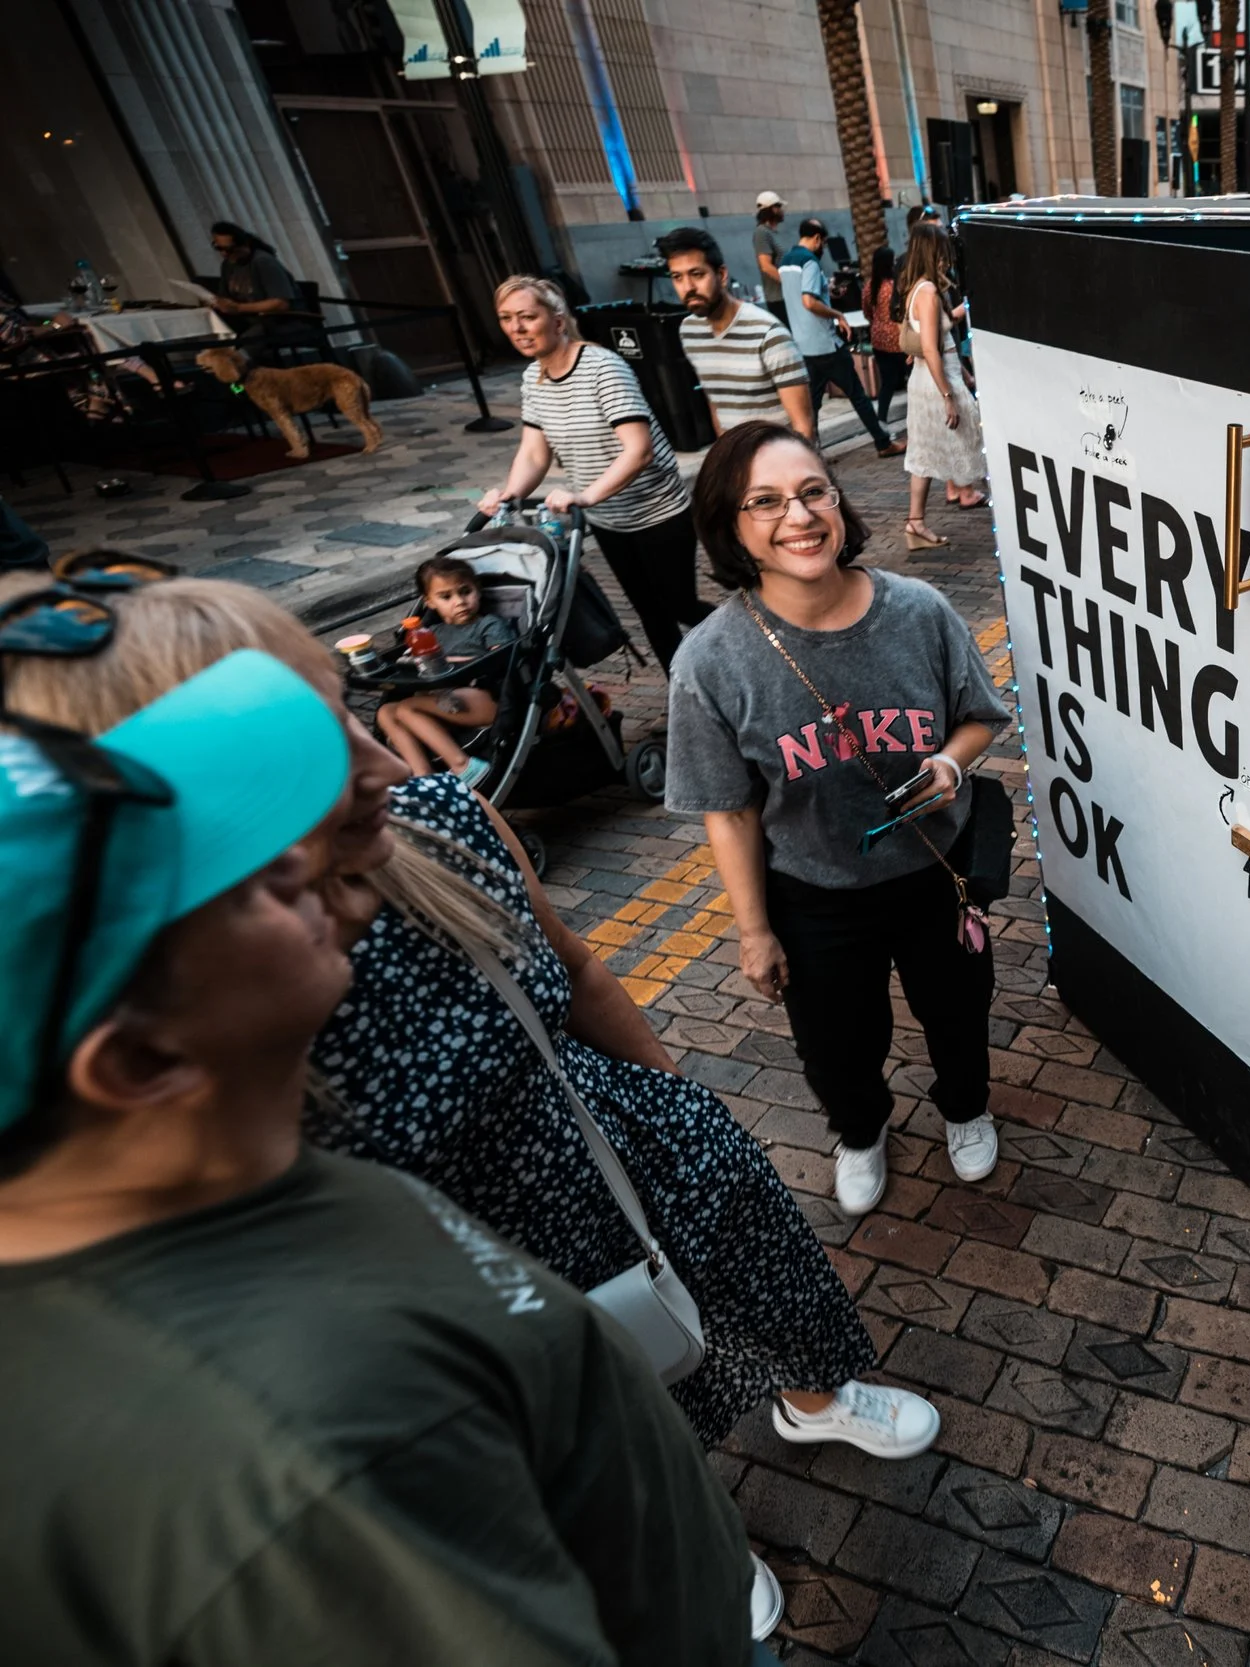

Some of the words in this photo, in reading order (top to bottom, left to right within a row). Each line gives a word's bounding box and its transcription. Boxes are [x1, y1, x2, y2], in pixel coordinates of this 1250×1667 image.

[1020, 565, 1239, 780] THING
[1036, 673, 1093, 783] IS
[777, 708, 936, 782] NKE
[1049, 776, 1133, 903] OK
